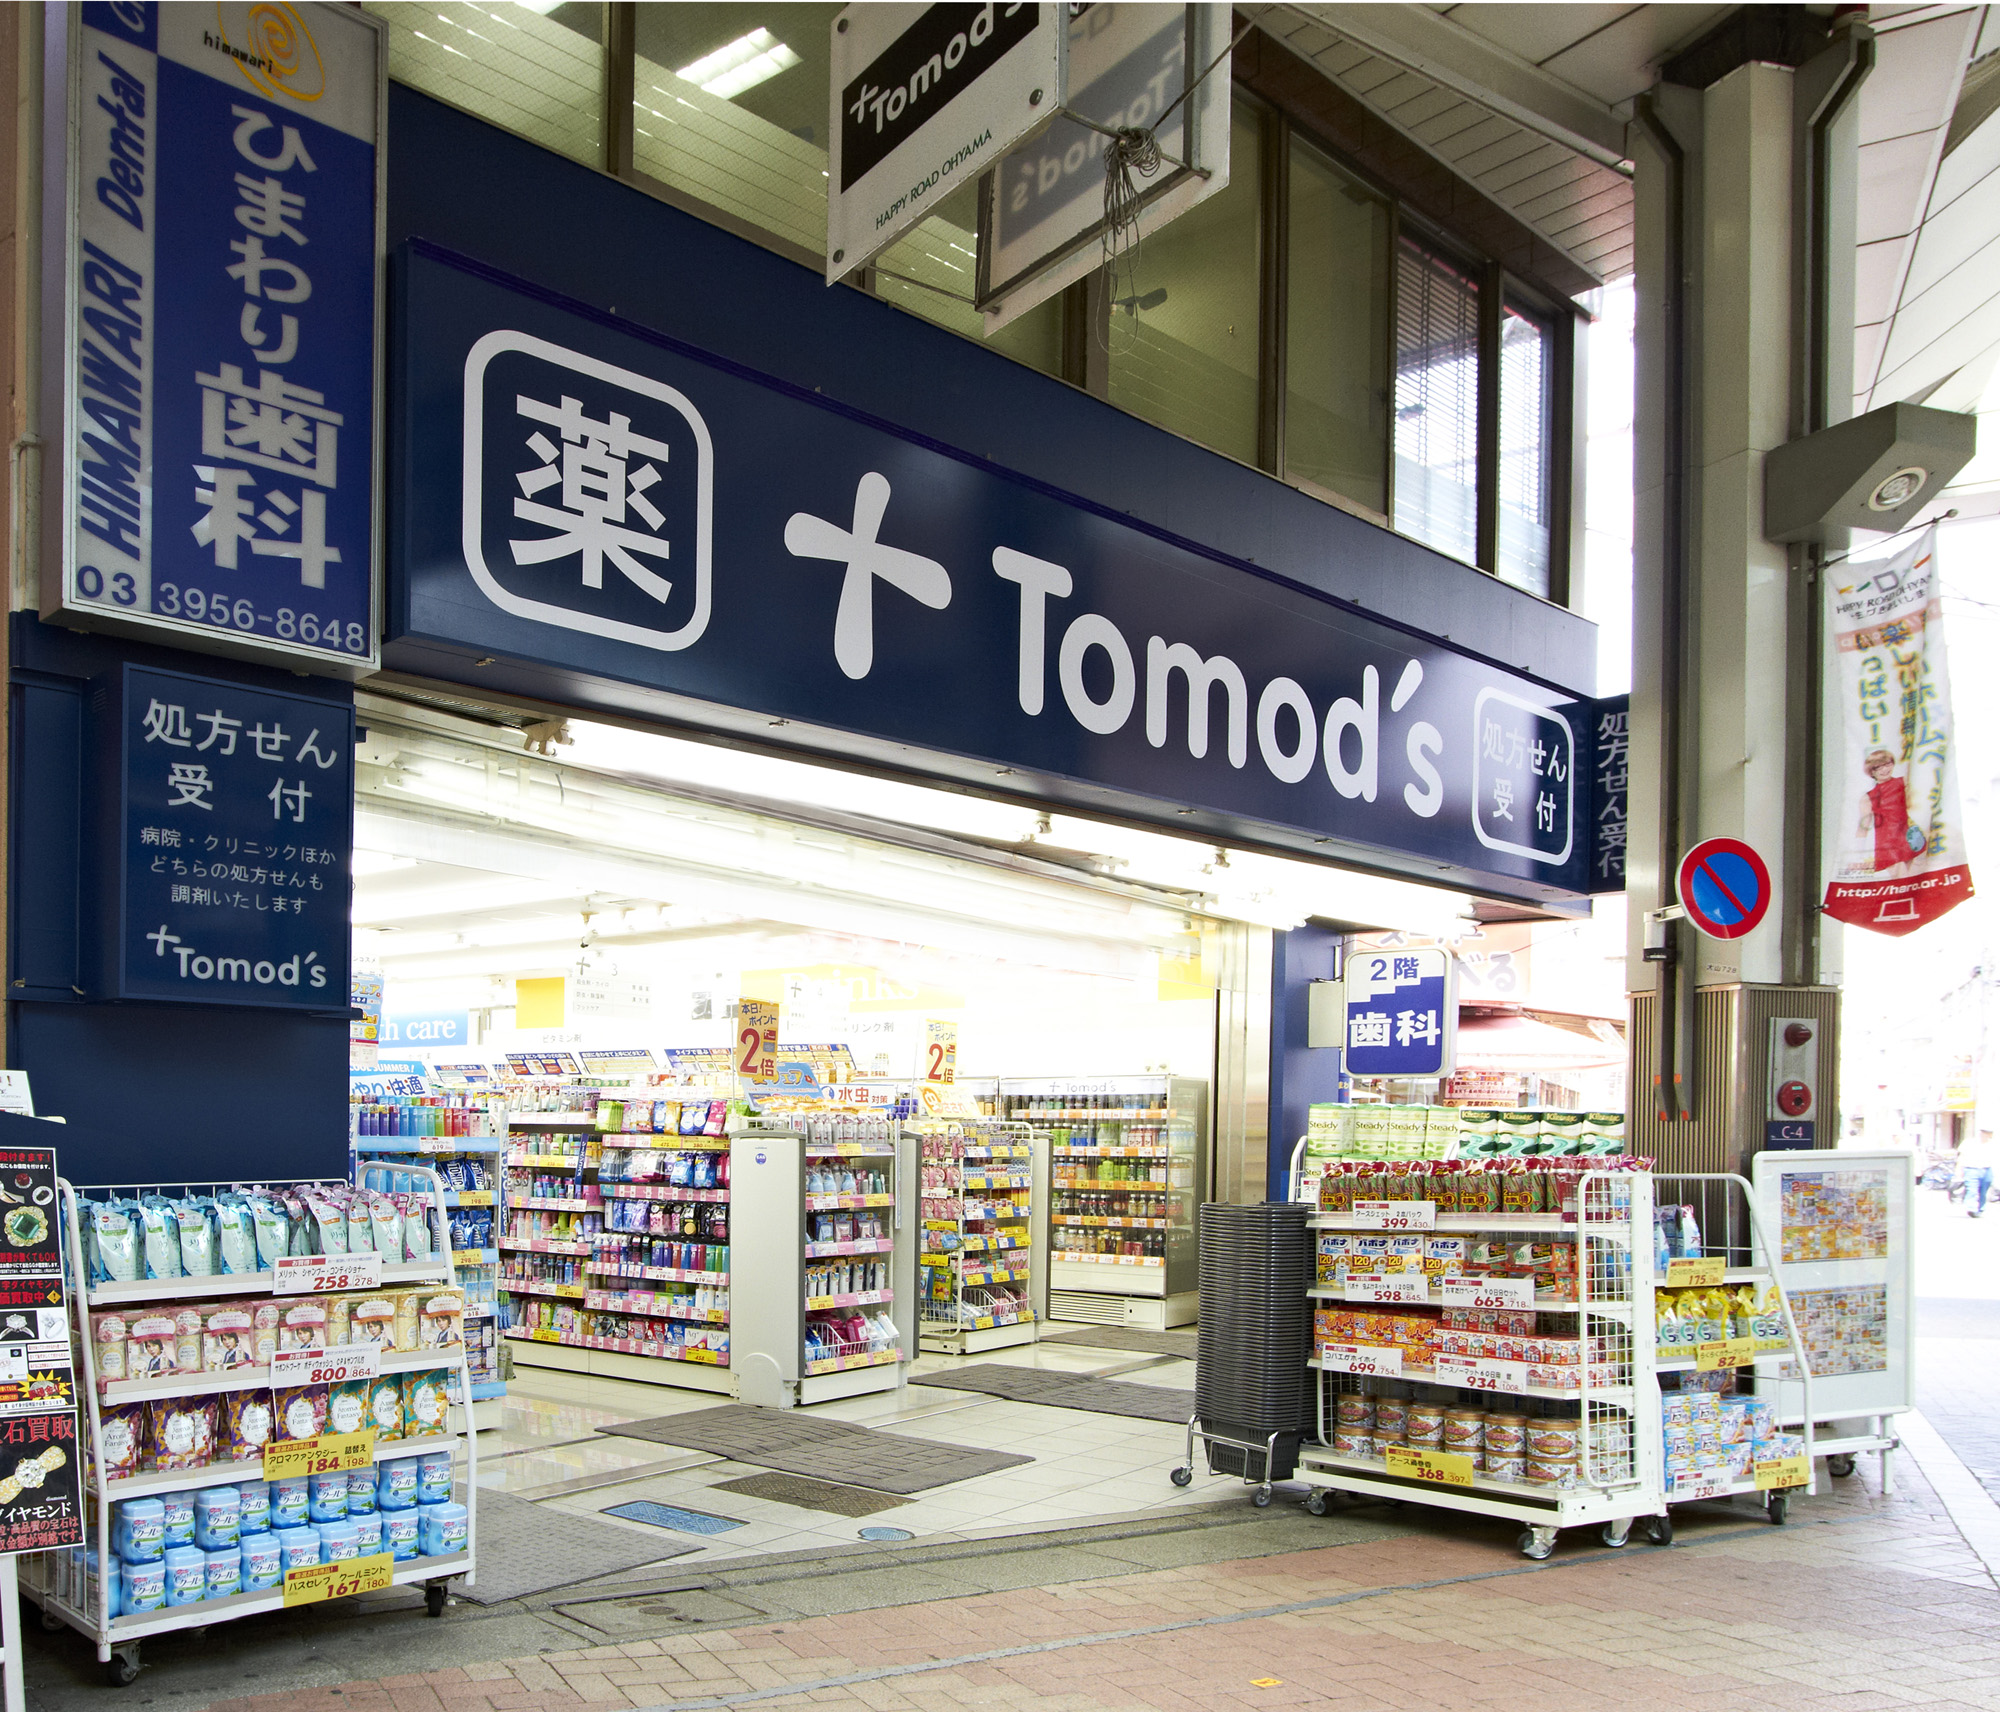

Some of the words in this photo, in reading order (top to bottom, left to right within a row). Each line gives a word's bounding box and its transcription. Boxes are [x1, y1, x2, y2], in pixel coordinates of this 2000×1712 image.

[203, 31, 274, 73] himawari
[97, 50, 145, 232] Dental
[875, 197, 907, 231] HAPPY
[910, 171, 940, 204] ROAD
[941, 128, 993, 177] OHYAMA
[190, 103, 344, 590] ひまわり歯科
[79, 238, 144, 562] HIMAWARI
[508, 393, 673, 604] 薬
[76, 565, 138, 606] 03
[158, 582, 365, 653] 3956-8648
[991, 545, 1444, 818] Tomod's
[142, 698, 338, 770] 処方せん
[1482, 716, 1568, 785] 処方せん
[167, 762, 213, 811] 受
[267, 777, 313, 823] 付
[1492, 777, 1514, 822] 受
[1535, 790, 1557, 834] 付
[140, 826, 337, 866] 病院・クリニックほか
[150, 854, 324, 891] どちらの処方せんも
[170, 883, 308, 915] 調剤いたします
[172, 946, 327, 989] Tomod's
[1370, 957, 1419, 981] 2階
[741, 1003, 763, 1014] 本日!
[748, 1014, 777, 1026] ポイント
[1349, 1009, 1441, 1047] 歯科
[406, 1018, 456, 1040] care
[542, 1033, 582, 1043] ビタミン剤
[740, 1028, 760, 1074] 2
[760, 1058, 775, 1077] 倍
[928, 1043, 944, 1081] 2
[1065, 1080, 1116, 1093] Tomod's
[838, 1086, 869, 1103] 水虫
[871, 1095, 888, 1104] 対策
[1308, 1120, 1338, 1130] Steady
[1355, 1121, 1385, 1130] Steady
[1390, 1122, 1419, 1131] Steady
[1428, 1123, 1459, 1134] Steady
[1781, 1125, 1804, 1139] C-4
[1381, 1218, 1408, 1228] 399
[1323, 1238, 1348, 1246] バポナ
[1393, 1238, 1420, 1246] バポナ
[1430, 1241, 1459, 1249] バポナ
[278, 1270, 297, 1278] メリット
[1689, 1275, 1706, 1285] 175
[313, 1275, 349, 1290] 258
[354, 1277, 373, 1287] 278
[1374, 1291, 1401, 1301] 598
[1474, 1296, 1504, 1307] 665
[1509, 1300, 1526, 1308] 718
[1325, 1352, 1377, 1363] コバエがホイホイ
[1717, 1356, 1736, 1367] 82
[310, 1367, 346, 1383] 800
[352, 1368, 371, 1378] 864
[1349, 1362, 1376, 1373] 699
[1380, 1367, 1395, 1375] 754
[1467, 1376, 1497, 1389] 934
[268, 1450, 338, 1465] アロマファンタジー
[307, 1457, 340, 1473] 184
[346, 1457, 365, 1467] 198
[1417, 1467, 1444, 1481] 368
[1449, 1474, 1465, 1484] 397
[1776, 1476, 1793, 1486] 167
[1694, 1486, 1714, 1498] 230
[288, 1576, 331, 1591] バスセレブ
[339, 1565, 386, 1581] クールミント
[327, 1580, 361, 1598] 167
[366, 1578, 385, 1589] 180
